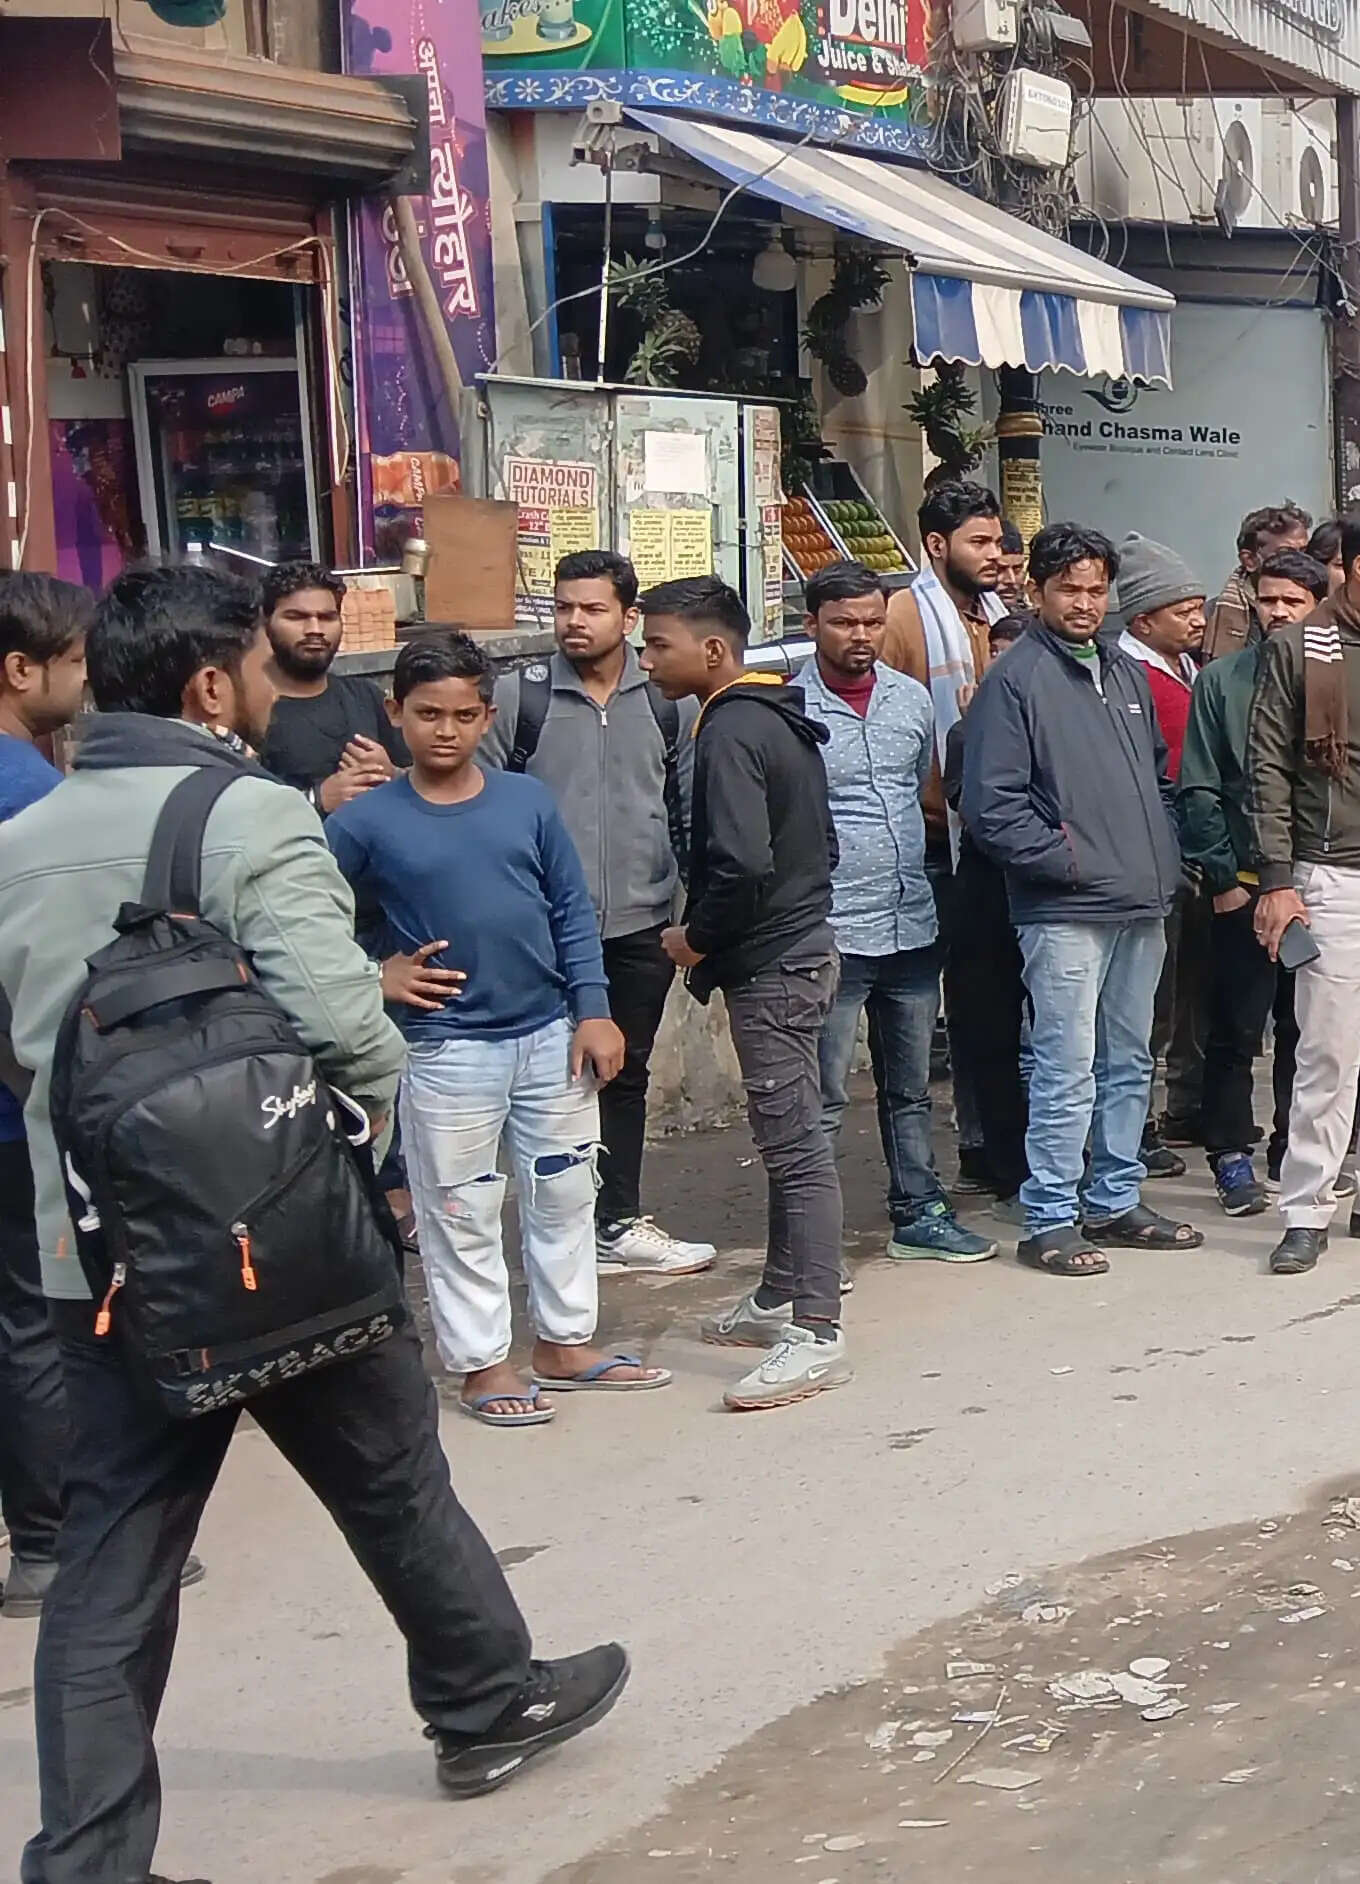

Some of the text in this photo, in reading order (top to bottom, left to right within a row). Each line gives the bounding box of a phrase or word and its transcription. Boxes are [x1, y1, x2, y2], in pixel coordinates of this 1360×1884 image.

[829, 0, 906, 46] Delhi
[817, 38, 867, 72] Juice
[872, 47, 884, 74] &
[1042, 419, 1241, 444] hand Chasma Wale
[512, 465, 590, 488] DIAMOND
[512, 485, 589, 508] TUTORIALS
[518, 510, 540, 520] rash
[185, 1313, 395, 1416] SKYBAGS
